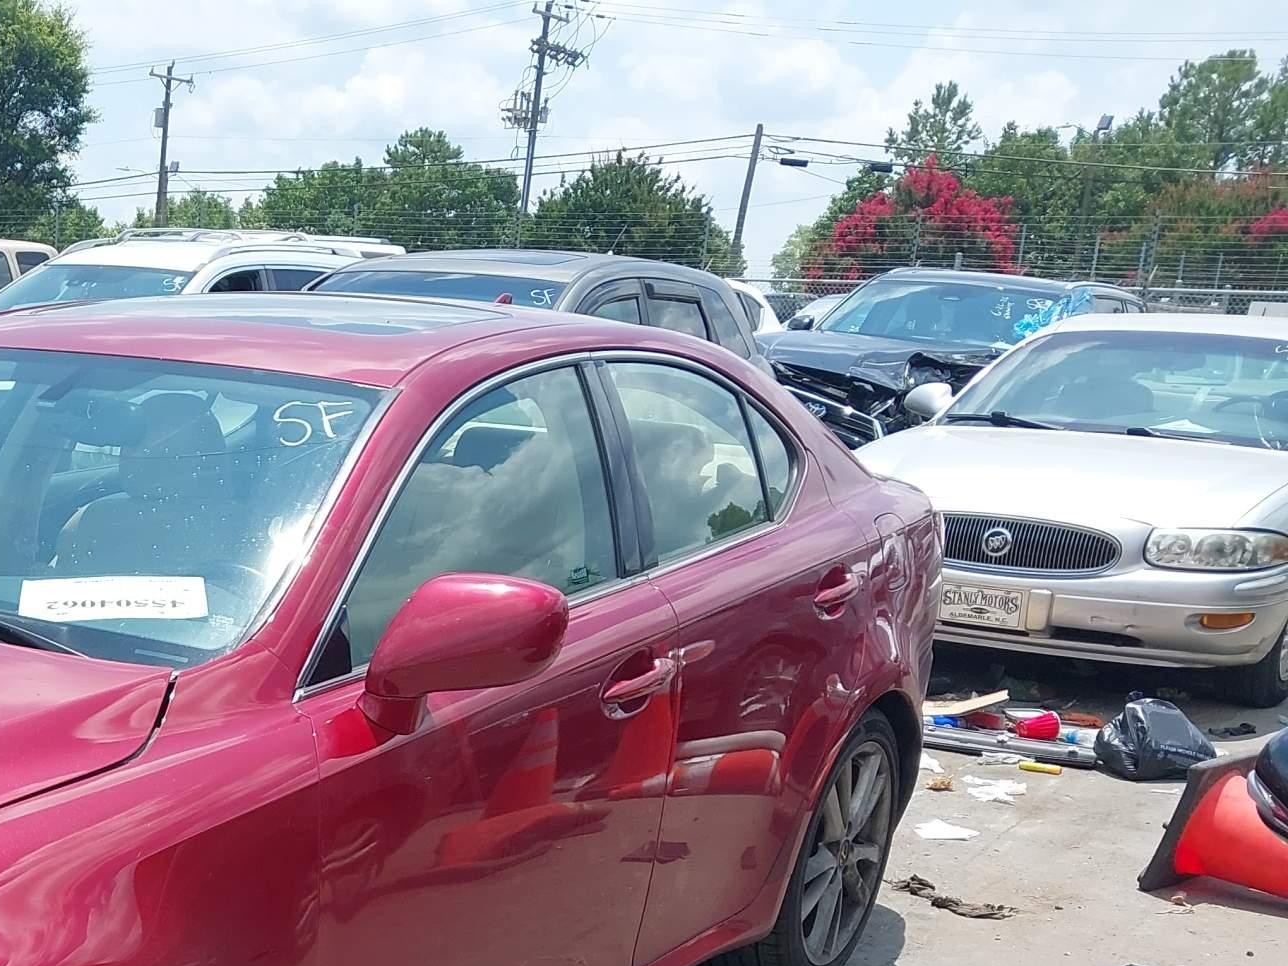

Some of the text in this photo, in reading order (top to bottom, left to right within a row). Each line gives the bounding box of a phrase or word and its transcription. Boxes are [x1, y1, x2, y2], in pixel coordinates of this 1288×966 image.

[530, 288, 555, 305] SF
[273, 400, 354, 446] SF
[978, 590, 1019, 614] MOTORS
